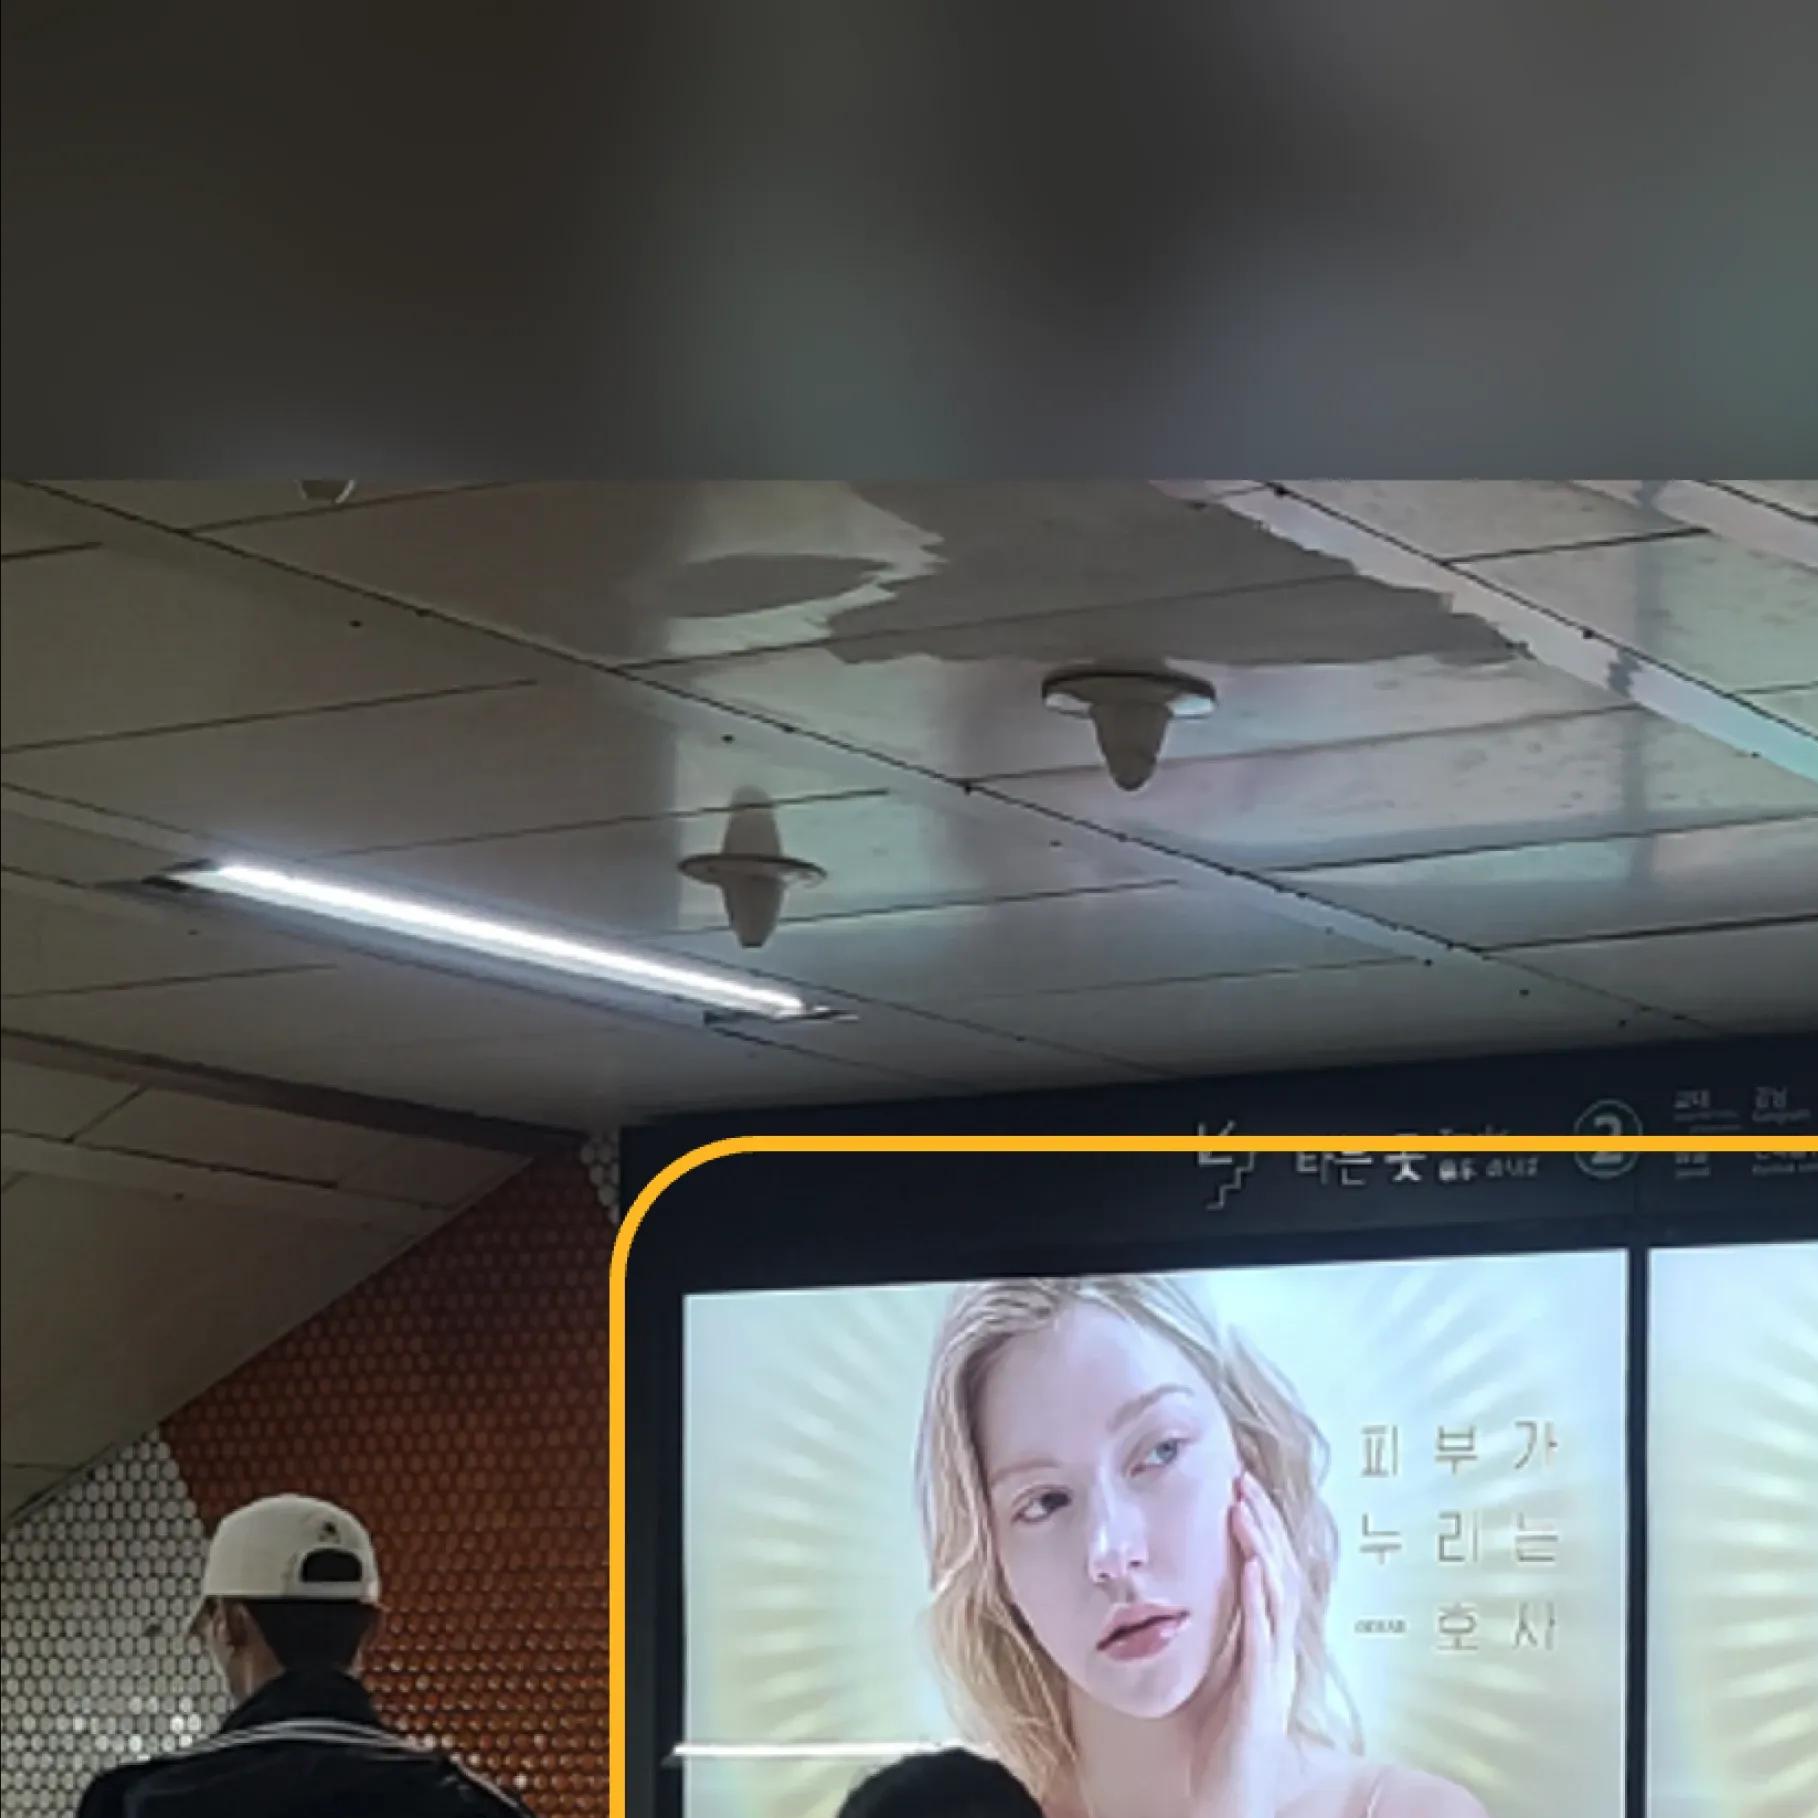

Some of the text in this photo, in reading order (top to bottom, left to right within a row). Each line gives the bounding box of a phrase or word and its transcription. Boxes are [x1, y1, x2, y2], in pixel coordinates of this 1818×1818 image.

[1591, 1113, 1624, 1165] 2
[1360, 1420, 1558, 1478] 피부가
[1358, 1511, 1559, 1565] 누리는
[1436, 1600, 1556, 1651] 호사
